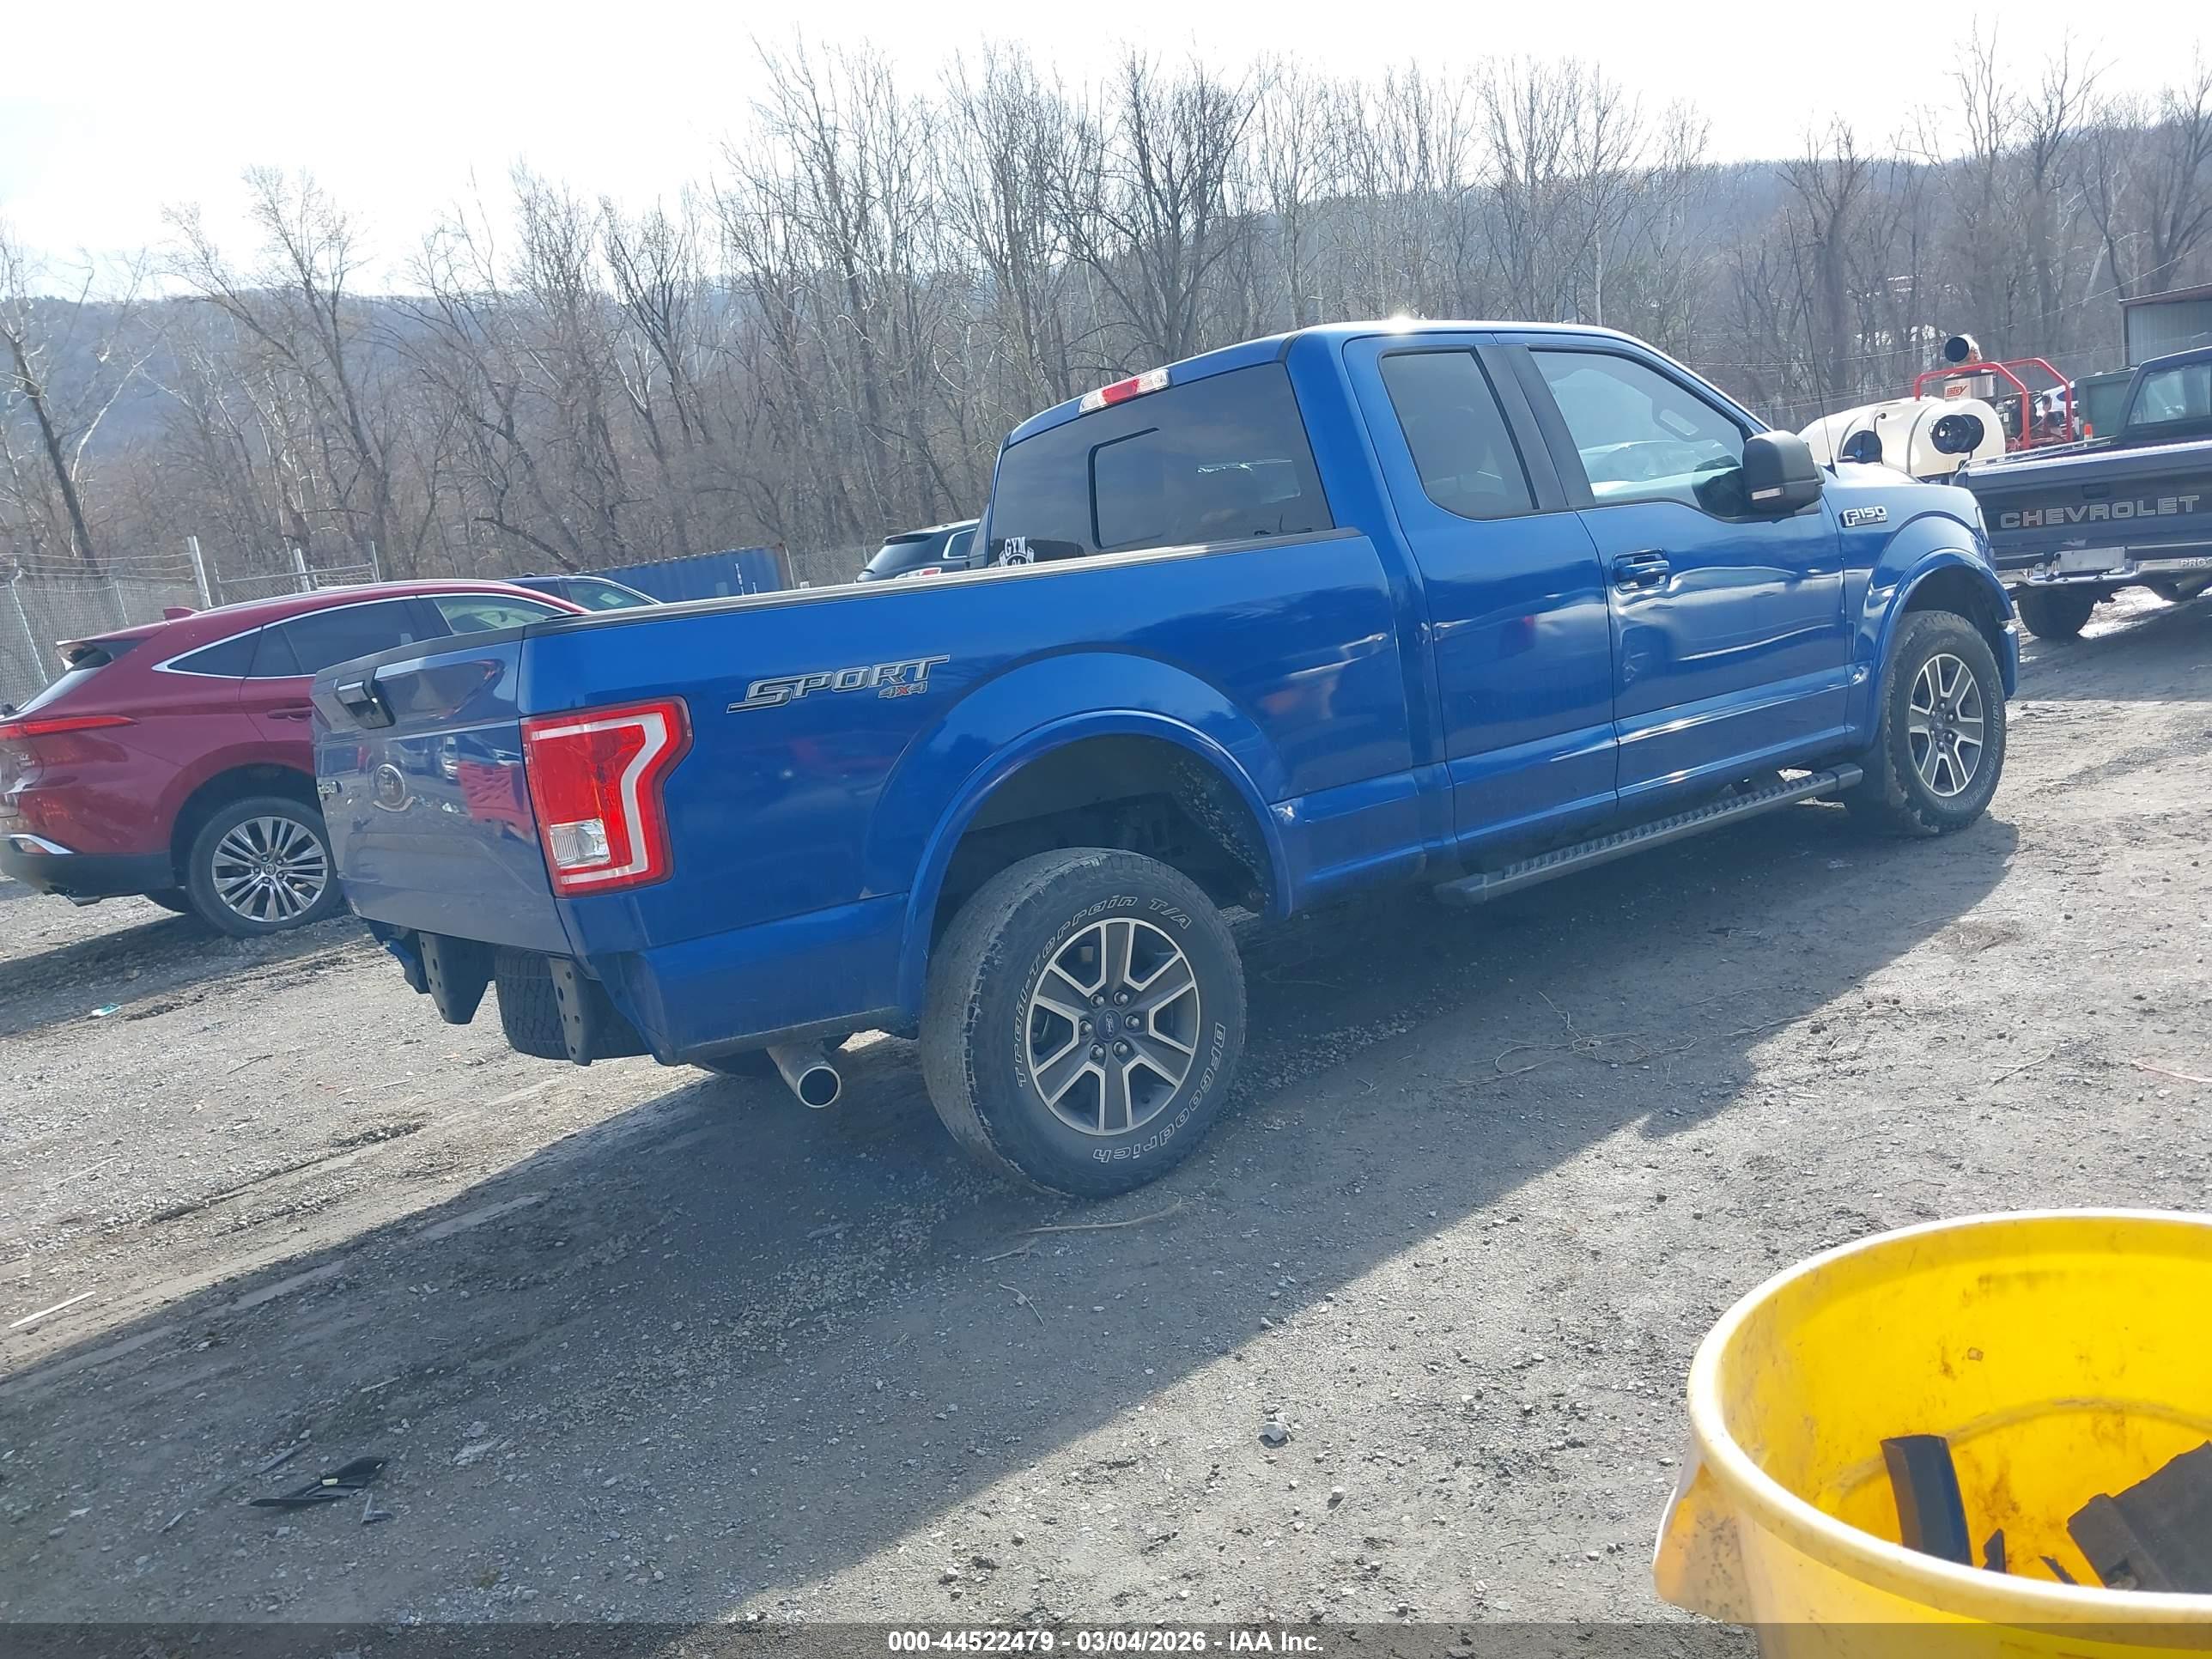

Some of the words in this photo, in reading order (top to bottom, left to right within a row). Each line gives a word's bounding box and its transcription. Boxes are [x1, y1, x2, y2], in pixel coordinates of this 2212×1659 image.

[1843, 506, 1887, 526] F150
[2000, 495, 2200, 530] CHEVROLET
[1004, 536, 1026, 556] GYM
[726, 654, 951, 714] SPORT
[1147, 897, 1194, 931] T/A
[1092, 1022, 1226, 1163] BFGoodrich
